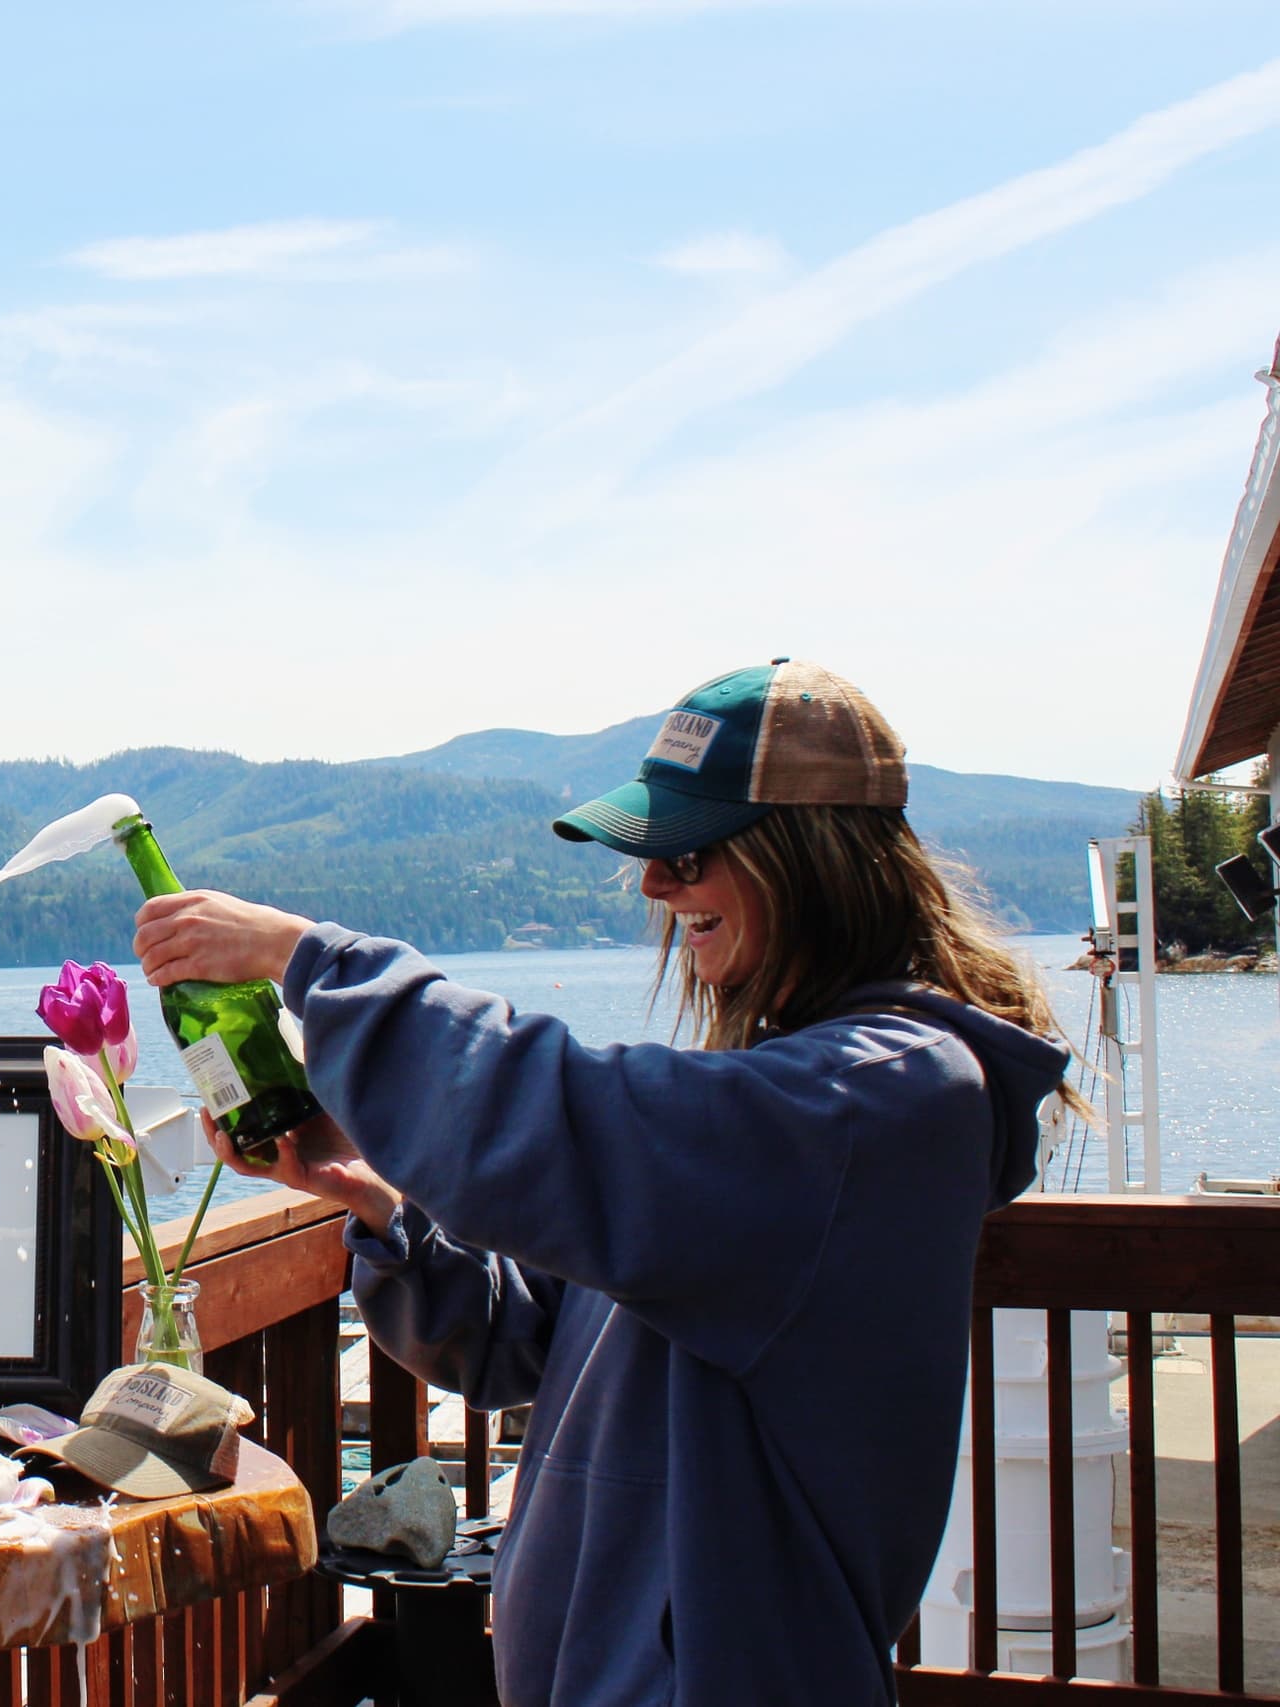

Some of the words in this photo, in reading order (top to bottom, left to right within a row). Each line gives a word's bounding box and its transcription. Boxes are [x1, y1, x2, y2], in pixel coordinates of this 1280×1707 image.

[663, 738, 702, 764] mpany
[136, 1379, 185, 1406] ISLAND
[115, 1391, 169, 1424] Company
